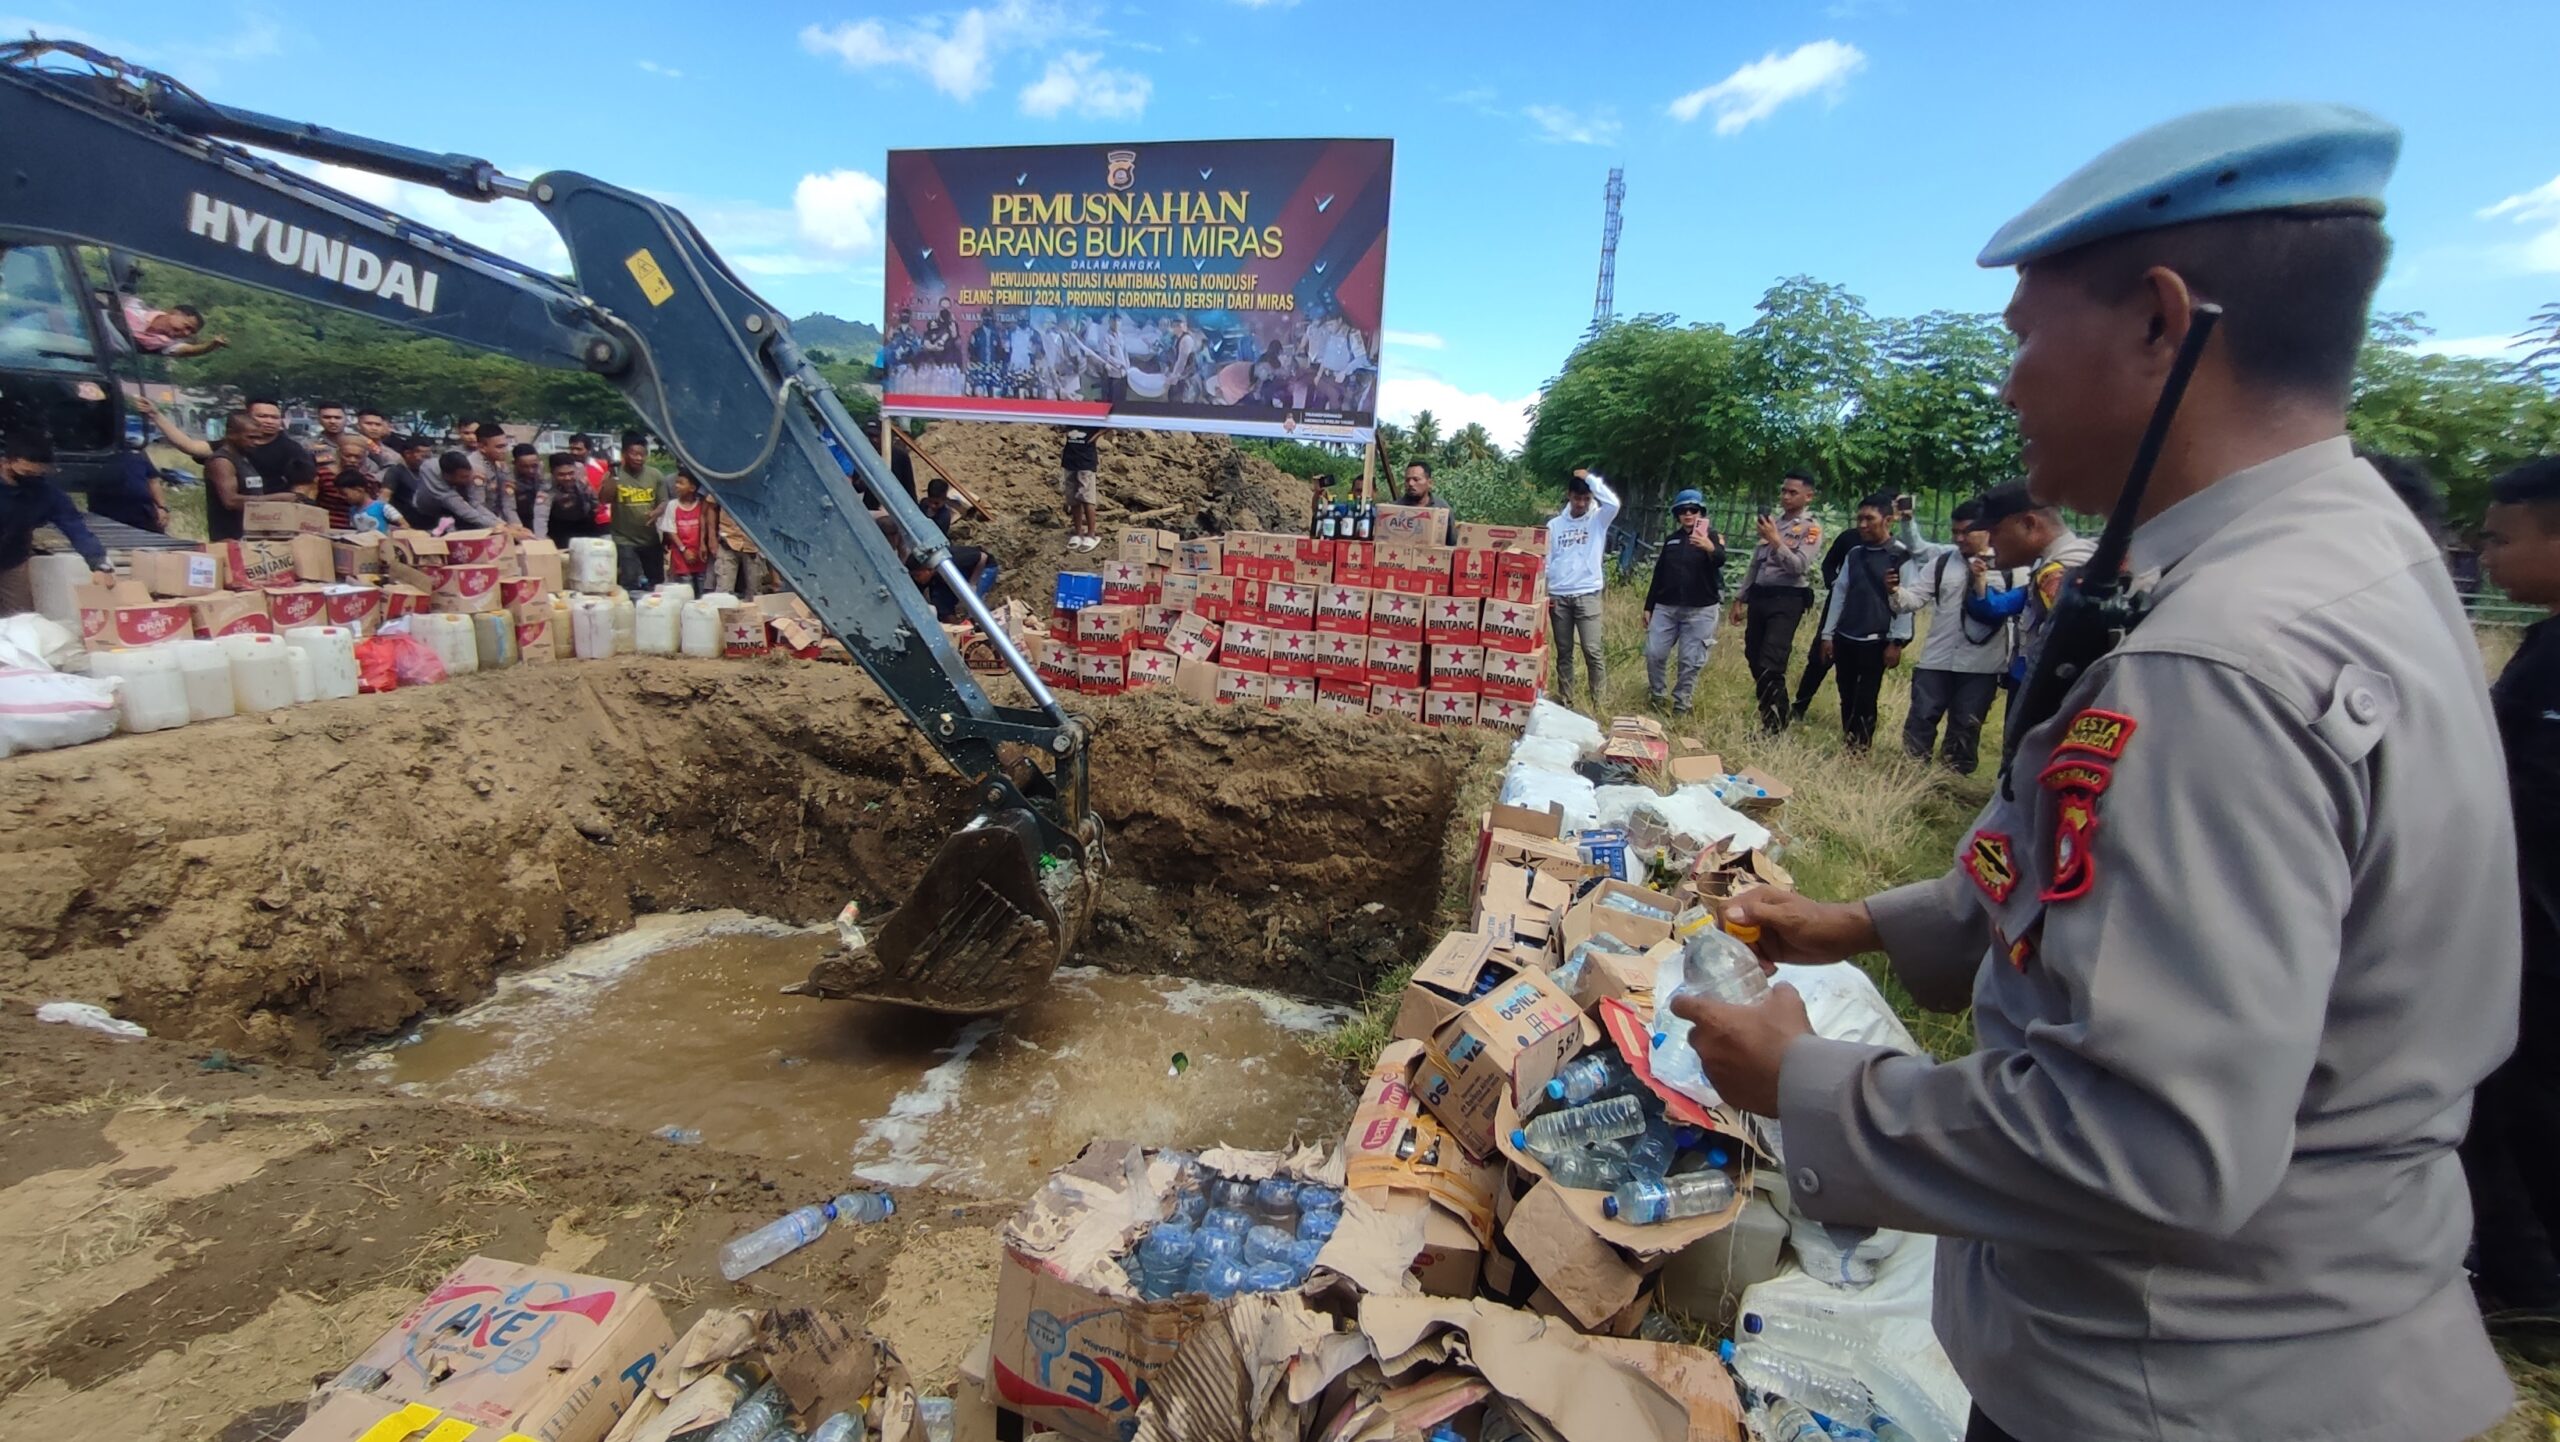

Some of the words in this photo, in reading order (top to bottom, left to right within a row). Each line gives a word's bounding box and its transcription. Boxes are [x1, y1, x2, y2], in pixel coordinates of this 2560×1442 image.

[991, 190, 1250, 225] PEMUSNAHAN
[958, 226, 1078, 258] BARANG
[1085, 226, 1173, 258] BUKTI
[1182, 225, 1284, 259] MIRAS
[190, 191, 438, 313] HYUNDAI
[1071, 260, 1110, 271] DALAM
[1113, 260, 1161, 271] RANGKA
[990, 272, 1059, 288] MEWUJUDKAN
[1061, 272, 1101, 289] SITUASI
[1103, 273, 1167, 290] KAMTIBMAS
[1169, 273, 1198, 290] YANG
[1200, 274, 1259, 291] KONDUSIF
[957, 289, 994, 306] JELANG
[995, 289, 1033, 307] PEMILU
[1034, 290, 1064, 308] 2024,
[1066, 290, 1115, 308] PROVINSI
[1117, 291, 1181, 309] GORONTALO
[1184, 292, 1225, 310] BERSIH
[1227, 293, 1254, 310] DARI
[1256, 293, 1294, 311] MIRAS
[1388, 517, 1414, 530] AKE
[1126, 533, 1147, 545] AKE
[1264, 553, 1290, 561] BINTANG
[1378, 561, 1406, 570] BINTANG
[1417, 565, 1445, 574] BINTANG
[1105, 581, 1141, 593] BINTANG
[1268, 603, 1310, 618] BINTANG
[1320, 606, 1362, 621] BINTANG
[136, 614, 175, 633] DRAFT
[1373, 612, 1418, 628] BINTANG
[1429, 619, 1475, 631] BINTANG
[1080, 632, 1120, 643] BINTANG
[1484, 623, 1531, 640] BINTANG
[1224, 643, 1266, 659] BINTANG
[1272, 650, 1315, 664] BINTANG
[1317, 653, 1360, 668] BINTANG
[1369, 659, 1415, 675] BINTANG
[1040, 661, 1077, 680] BINTANG
[1130, 671, 1172, 684] BINTANG
[1434, 667, 1480, 678] BINTANG
[1082, 674, 1121, 686] BINTANG
[1485, 672, 1533, 688] BINTANG
[1321, 689, 1365, 707] BINTANG
[1428, 713, 1474, 726] BINTANG
[1481, 717, 1527, 734] BINTANG
[434, 1303, 539, 1348] AKE
[1127, 1355, 1163, 1370] MINUM
